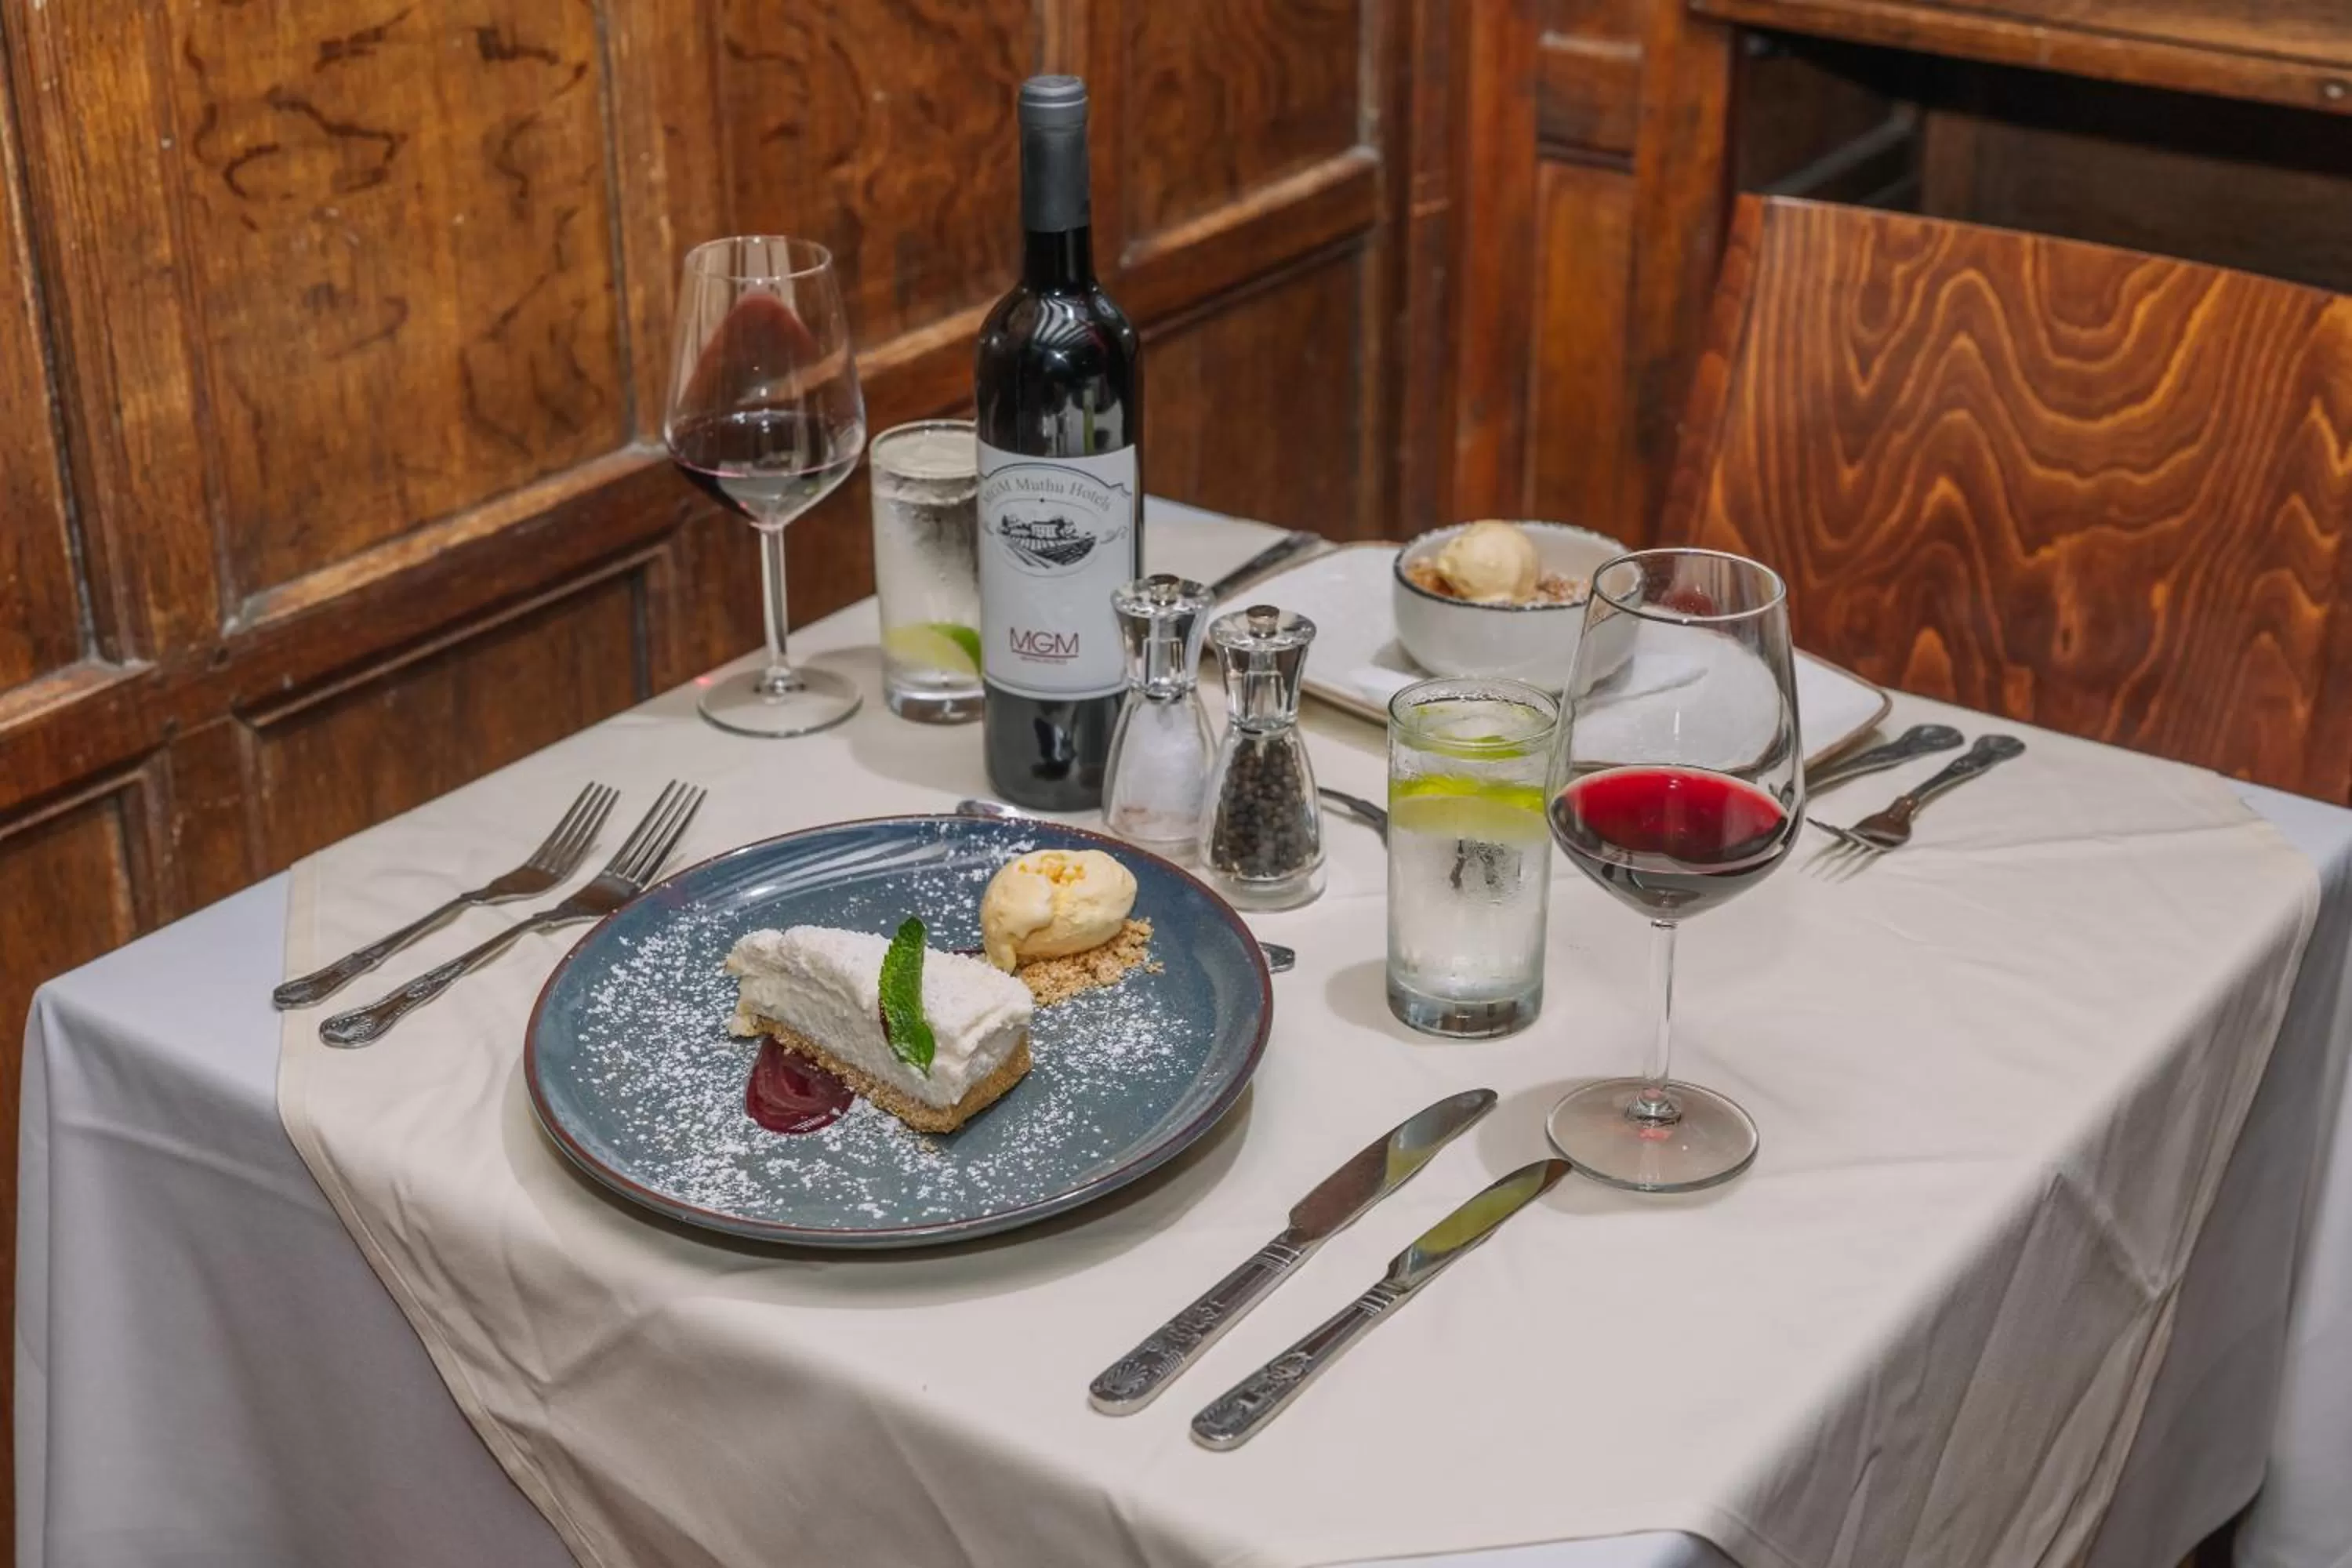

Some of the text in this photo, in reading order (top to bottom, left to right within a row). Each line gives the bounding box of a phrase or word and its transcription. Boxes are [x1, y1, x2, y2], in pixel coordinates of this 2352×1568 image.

[1015, 477, 1064, 494] Muthu
[1069, 481, 1110, 512] Hotels
[1009, 626, 1080, 653] MGM
